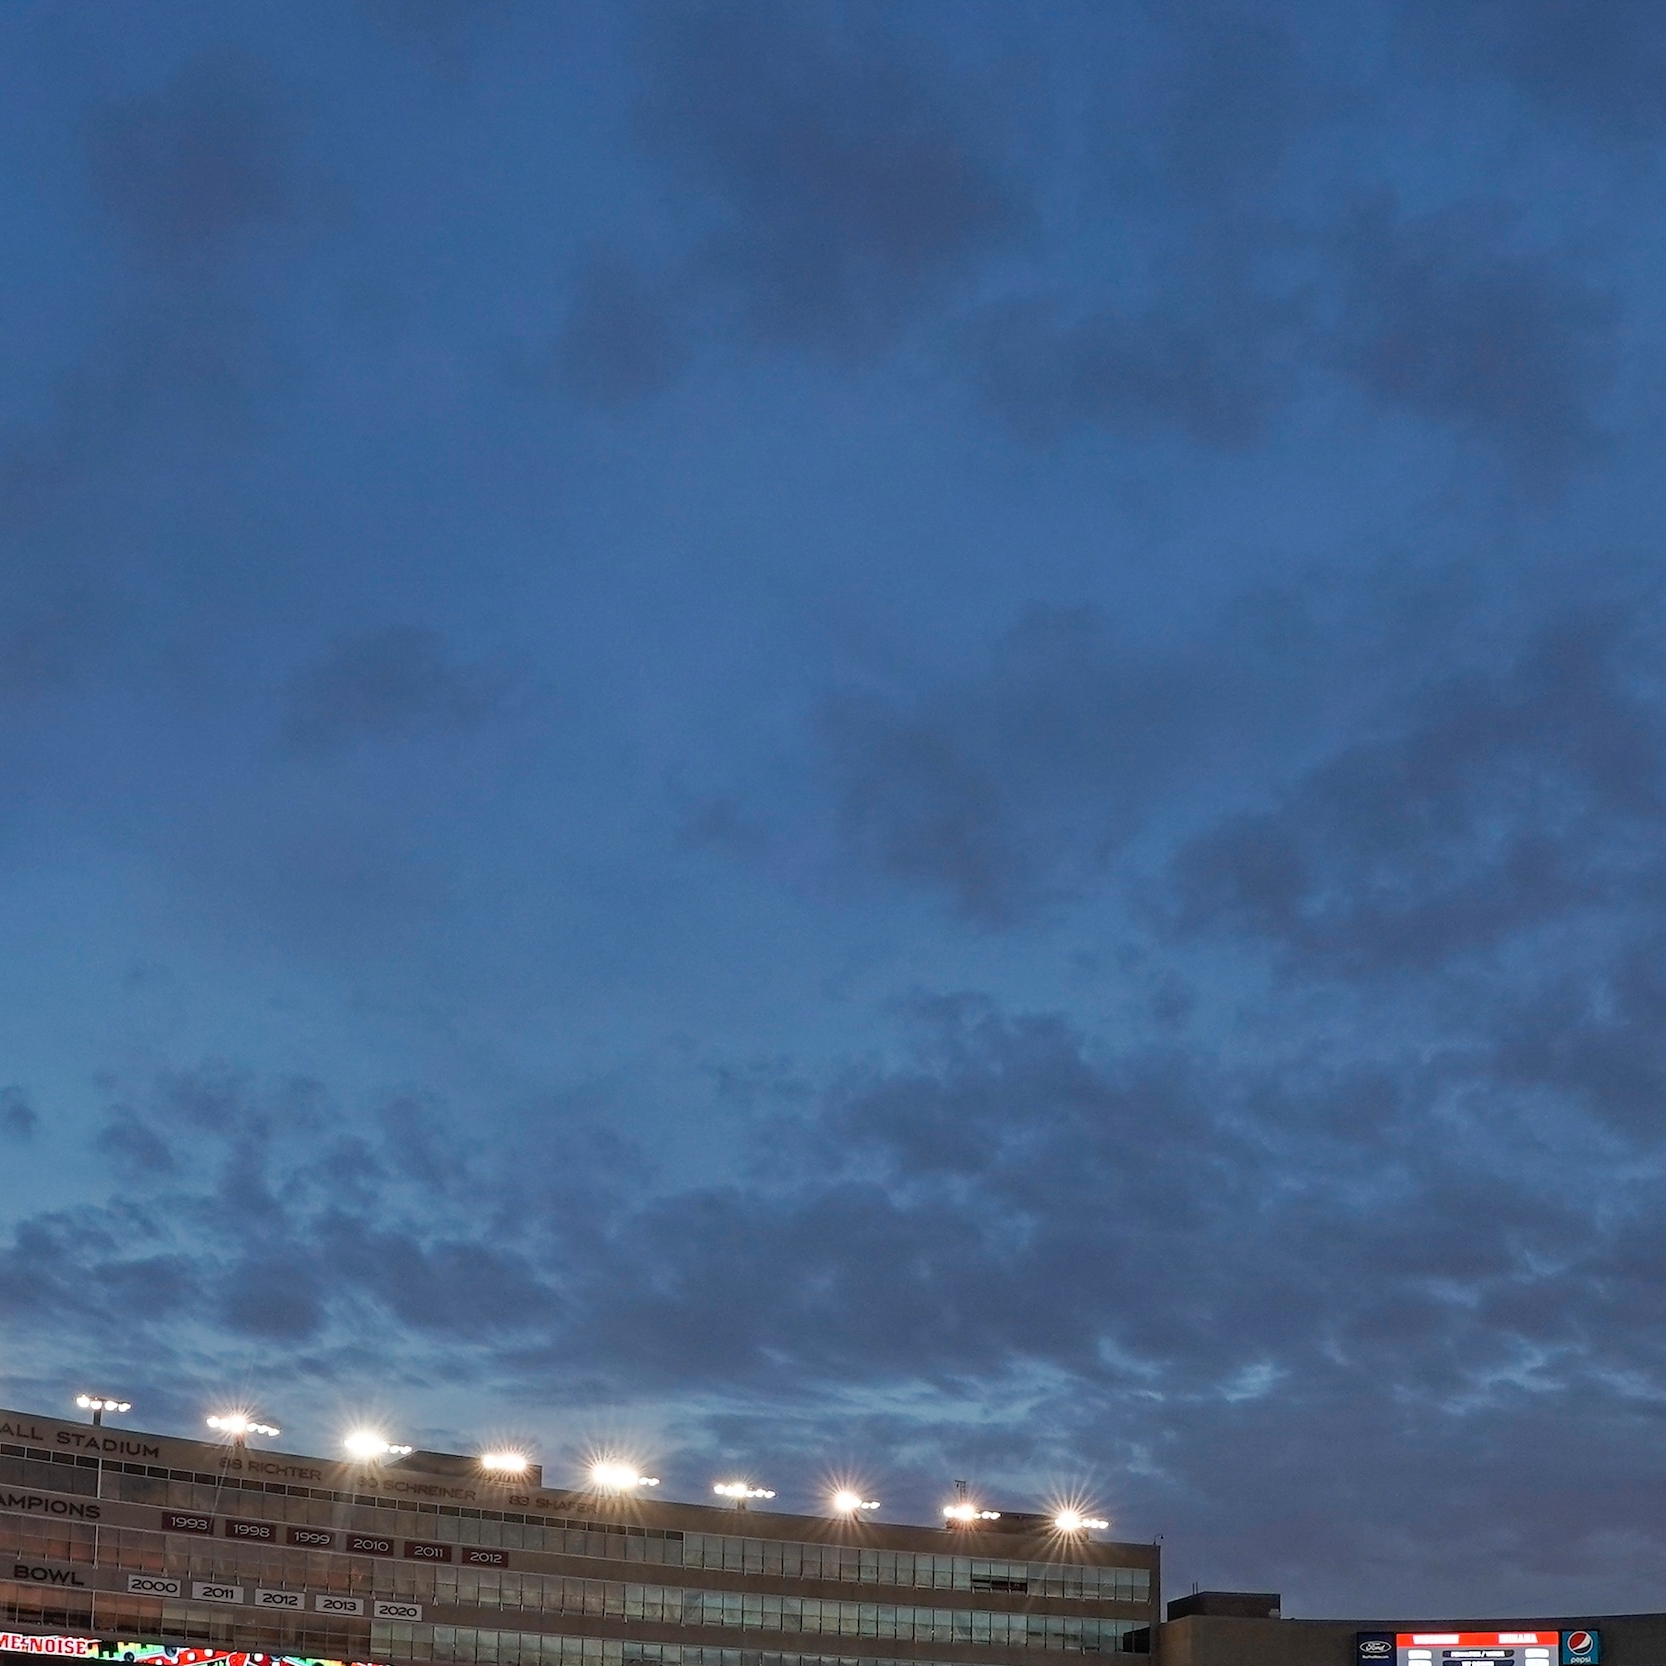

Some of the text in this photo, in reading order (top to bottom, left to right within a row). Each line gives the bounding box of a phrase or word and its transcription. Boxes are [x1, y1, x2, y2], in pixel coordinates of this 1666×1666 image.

[56, 1430, 161, 1459] STADIUM
[248, 1461, 322, 1482] RICHTER
[383, 1478, 477, 1501] SCHREINER
[535, 1497, 598, 1515] SHAFER
[170, 1515, 208, 1531] 1993
[232, 1522, 271, 1539] 1998
[293, 1530, 332, 1545] 1999
[352, 1537, 389, 1552] 2010
[413, 1545, 444, 1559] 2011
[469, 1550, 503, 1564] 2012
[13, 1564, 84, 1586] BOWL
[131, 1578, 178, 1593] 2000
[202, 1586, 235, 1600] 2011
[262, 1593, 298, 1606] 2012
[323, 1598, 357, 1612] 2013
[378, 1604, 417, 1617] 2020
[29, 1636, 87, 1656] NOISE
